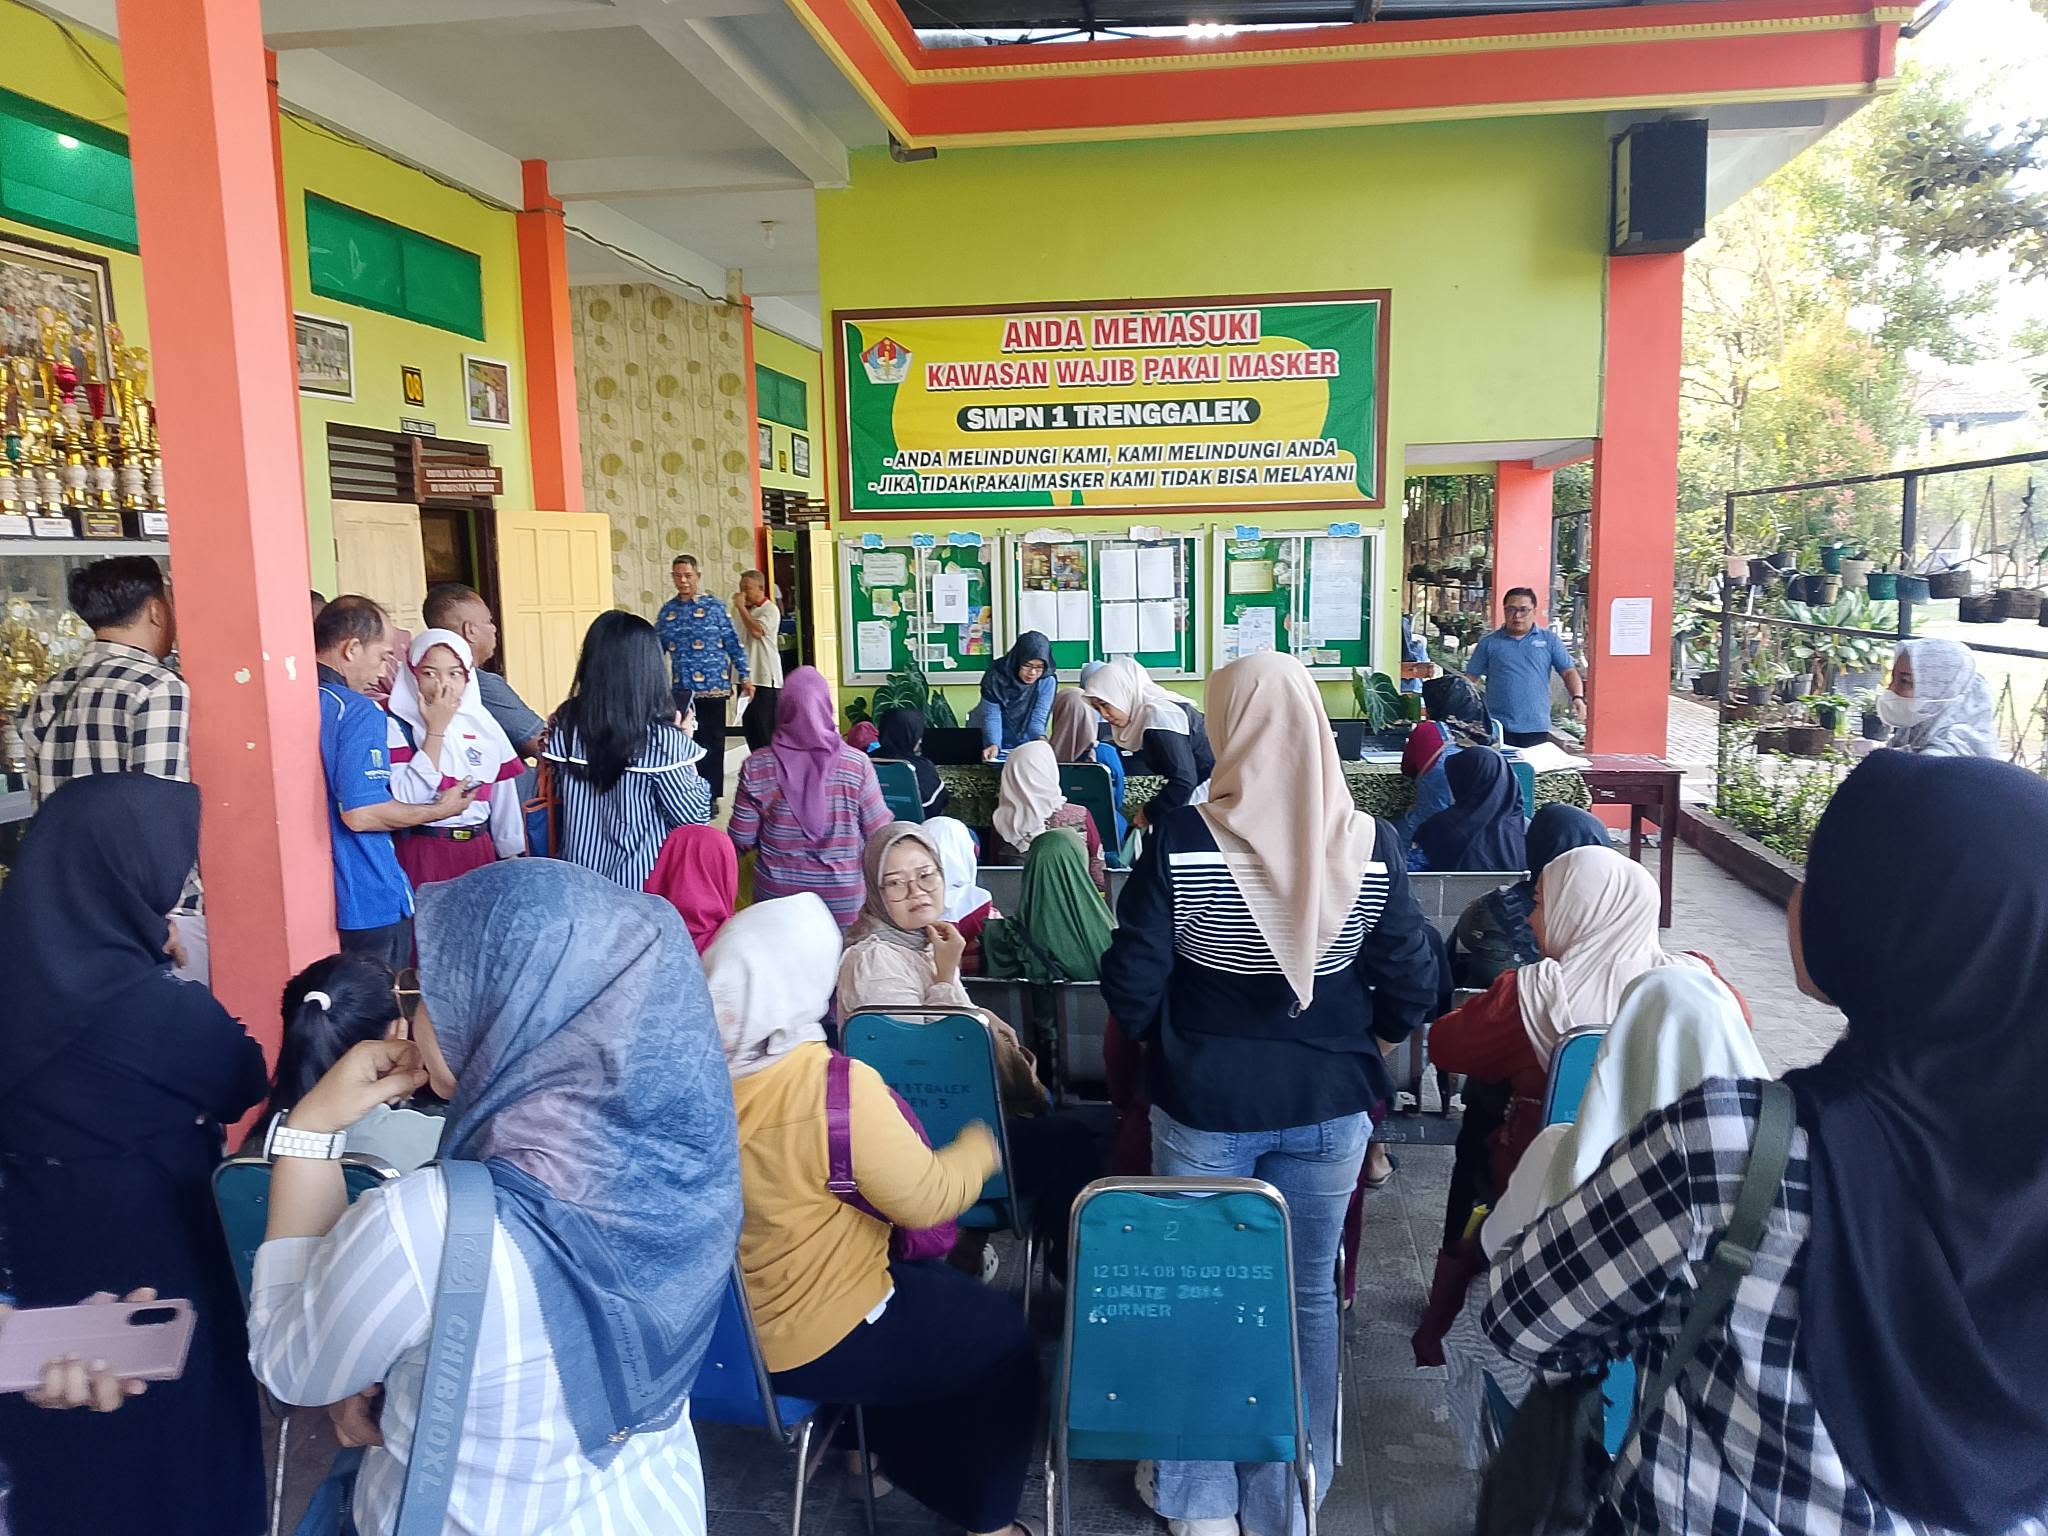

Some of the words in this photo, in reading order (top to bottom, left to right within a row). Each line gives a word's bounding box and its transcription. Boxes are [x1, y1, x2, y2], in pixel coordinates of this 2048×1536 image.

[1003, 319, 1084, 348] ANDA
[1093, 312, 1258, 346] MEMASUKI
[927, 361, 1048, 387] KAWASAN
[1056, 358, 1134, 384] WAJIB
[1143, 355, 1220, 381] PAKAI
[1228, 351, 1338, 378] MASKER
[966, 406, 1044, 430] SMPN
[1051, 405, 1068, 428] 1
[1073, 400, 1251, 427] TRENGGALEK
[948, 448, 1057, 467] MELINDUNGI
[1062, 447, 1112, 467] KAMI,
[1117, 446, 1163, 462] KAMI
[1167, 442, 1281, 461] MELINDUNGI
[1286, 440, 1336, 458] ANDA
[921, 475, 973, 492] TIDAK
[975, 474, 1031, 491] PAKAI
[1031, 472, 1104, 489] MASKER
[1110, 470, 1155, 487] KAMI
[1160, 469, 1212, 487] TIDAK
[1216, 467, 1258, 485] BISA
[1263, 464, 1355, 483] MELAYANI
[1163, 1220, 1180, 1241] 2
